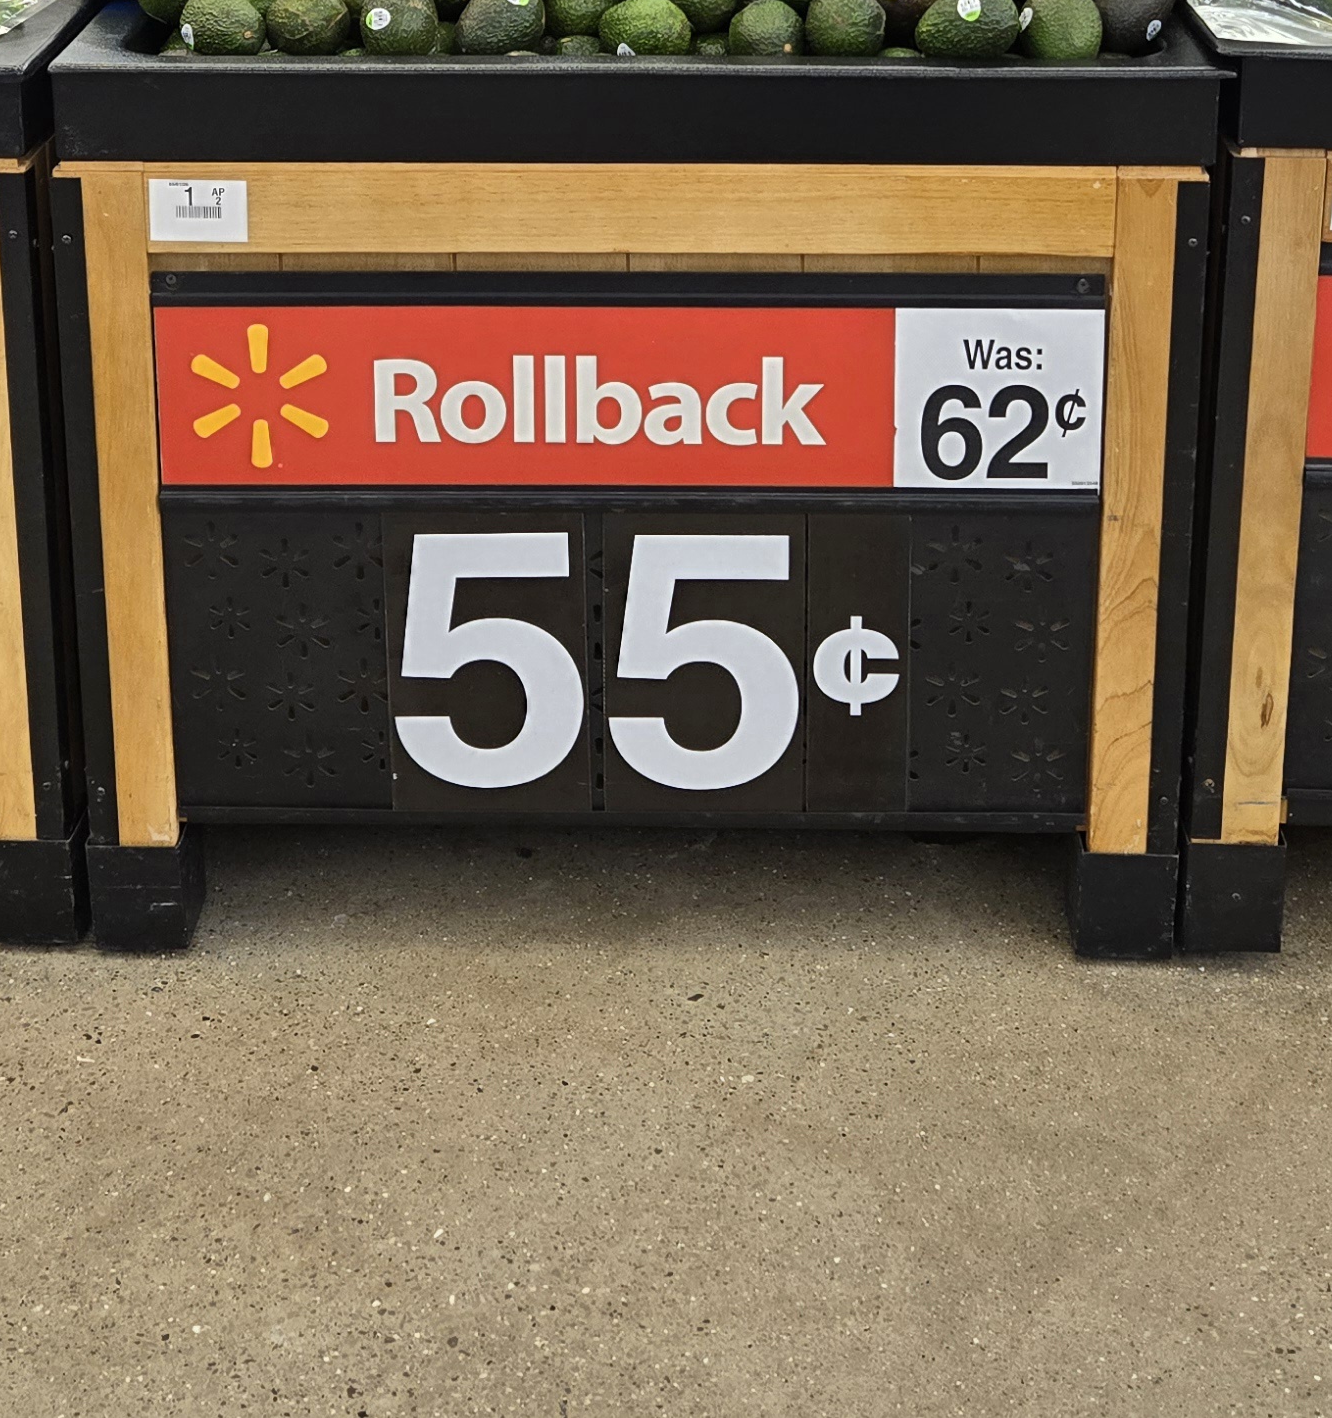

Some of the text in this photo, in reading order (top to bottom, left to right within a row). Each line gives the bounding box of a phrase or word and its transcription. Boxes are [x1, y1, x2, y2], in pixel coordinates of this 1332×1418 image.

[184, 186, 193, 207] 1
[211, 187, 225, 197] AP
[215, 196, 222, 206] 2
[963, 339, 1043, 371] Was:
[373, 353, 826, 446] Rollback
[920, 384, 1087, 481] 62¢
